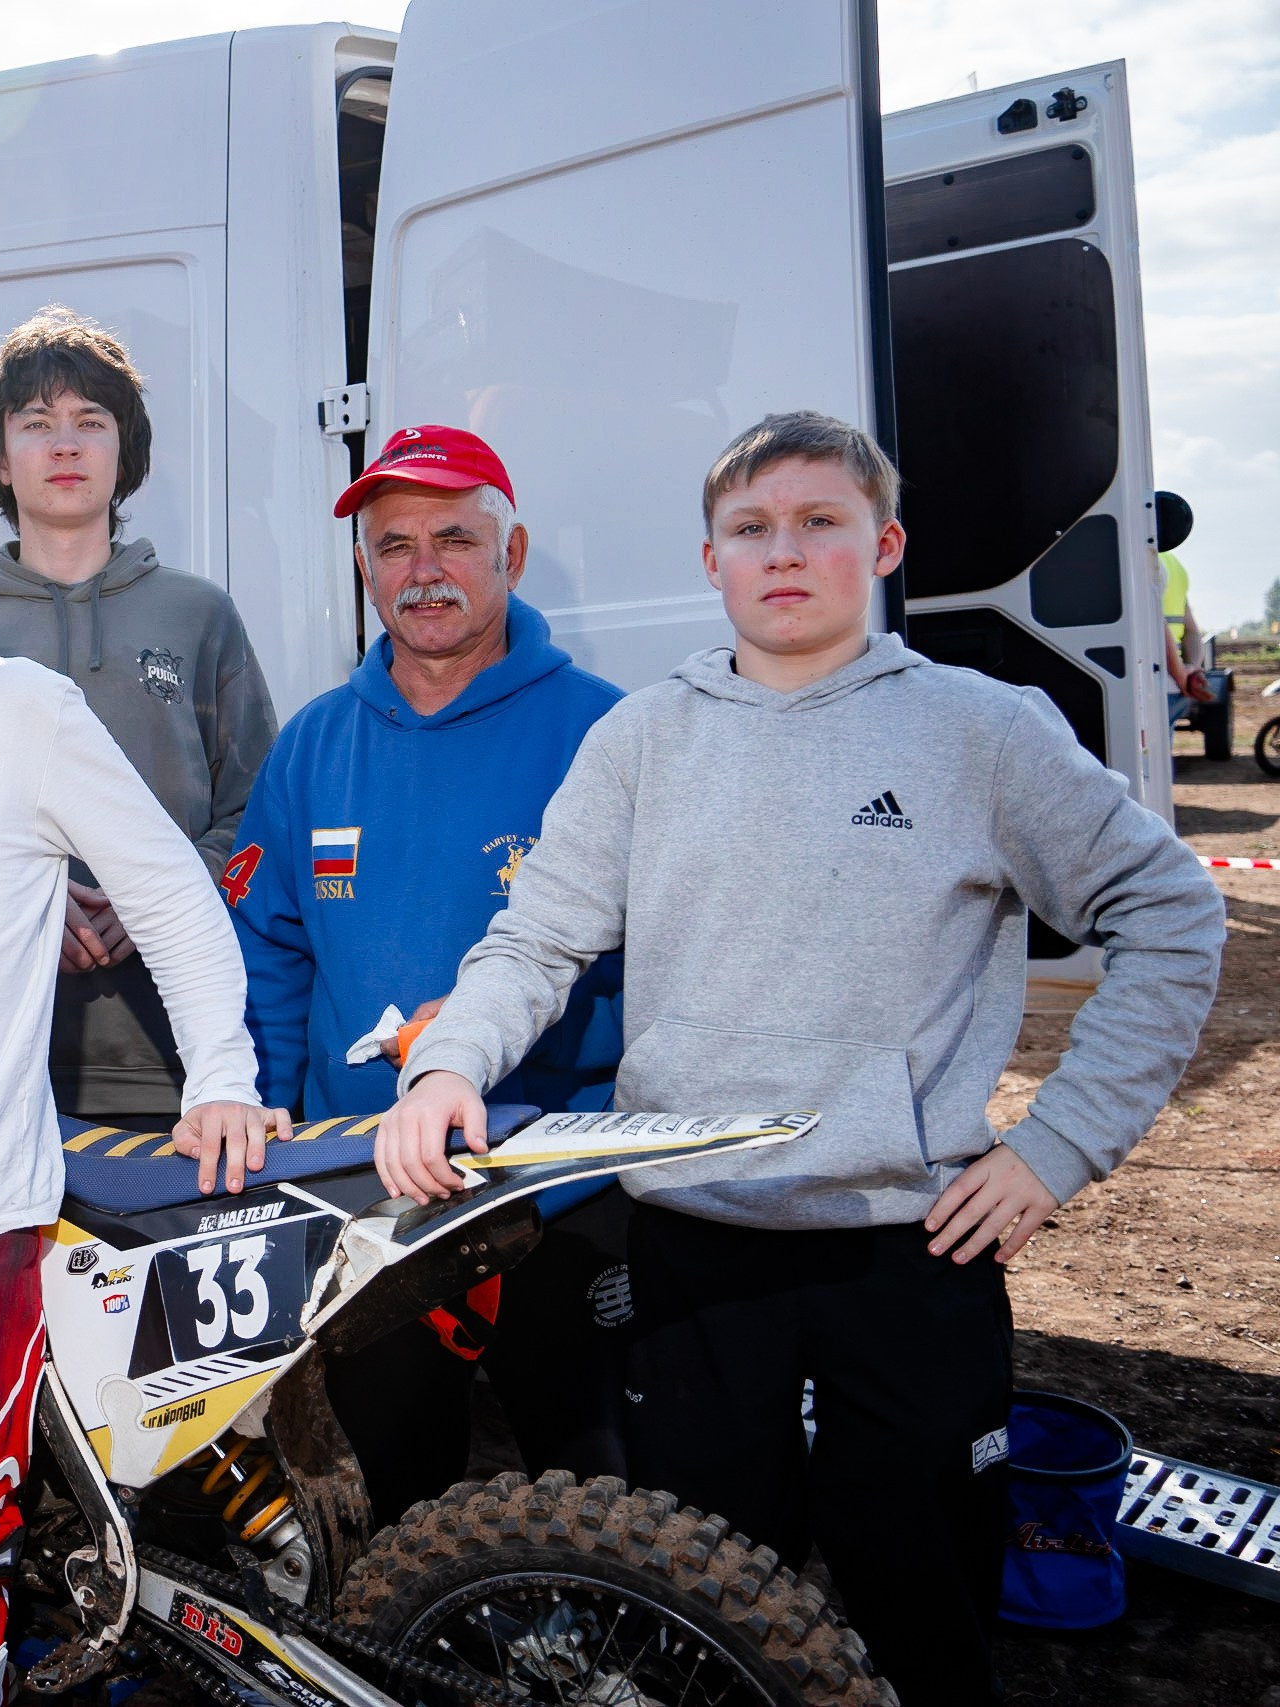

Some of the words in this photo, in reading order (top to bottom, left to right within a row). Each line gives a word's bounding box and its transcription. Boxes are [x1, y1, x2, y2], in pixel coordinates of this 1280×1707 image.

[851, 812, 913, 830] adidas
[482, 834, 518, 854] HARVEY
[220, 842, 264, 908] 4
[314, 879, 355, 900] USSIA
[187, 1234, 270, 1348] 33
[104, 1295, 129, 1312] 100%
